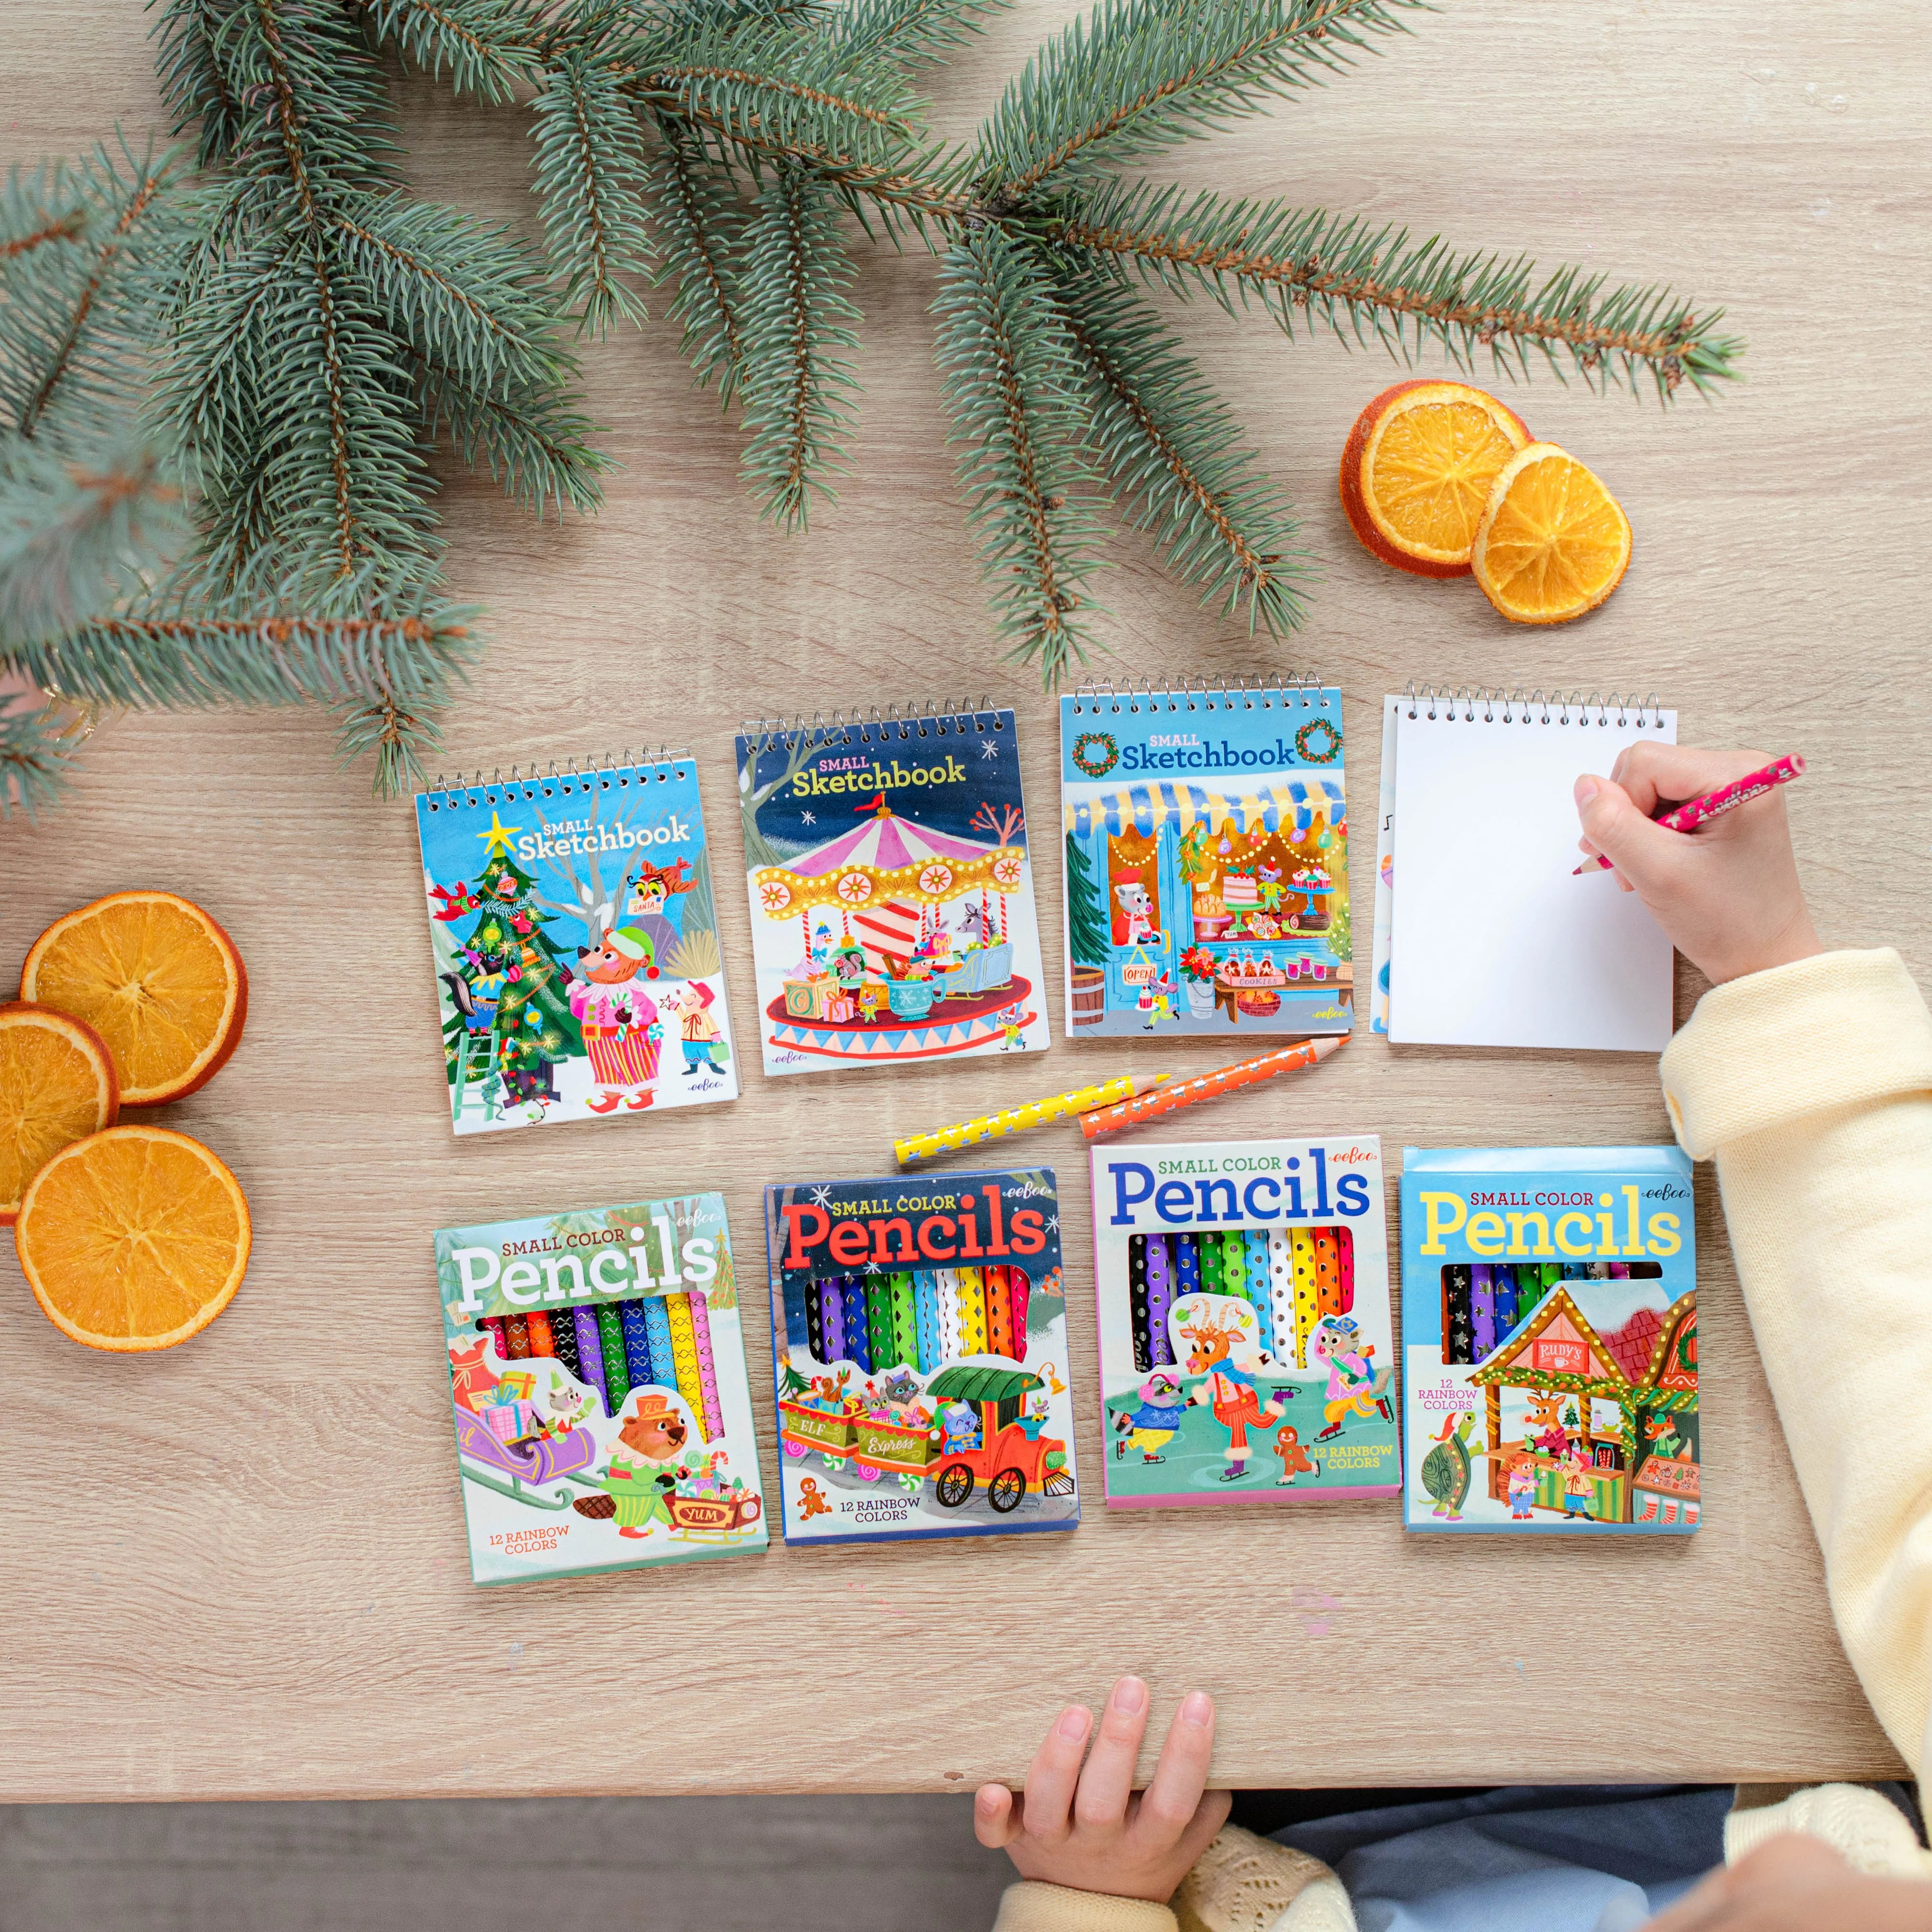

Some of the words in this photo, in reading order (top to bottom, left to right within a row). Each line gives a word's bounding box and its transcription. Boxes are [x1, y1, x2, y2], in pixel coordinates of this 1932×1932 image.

[1150, 734, 1199, 747] SMALL
[1122, 739, 1295, 770] Sketchbook
[819, 756, 869, 772] SMALL
[792, 755, 966, 796] Sketchbook
[543, 819, 593, 836] SMALL
[518, 816, 690, 860] Sketchbook
[633, 901, 655, 912] SANTA
[1128, 969, 1152, 980] OPEN
[1239, 978, 1277, 986] COOKIES
[1158, 1159, 1218, 1174] SMALL
[1223, 1157, 1281, 1172] COLOR
[1108, 1148, 1370, 1225] Pencils
[832, 1198, 893, 1217] SMALL
[896, 1195, 956, 1213] COLOR
[1471, 1192, 1530, 1206] SMALL
[1535, 1192, 1594, 1206] COLOR
[781, 1185, 1046, 1268] Pencils
[1420, 1185, 1682, 1257] Pencils
[502, 1237, 562, 1256] SMALL
[566, 1228, 626, 1248] COLOR
[452, 1215, 718, 1312] Pencils
[1540, 1344, 1582, 1359] RUDY'S
[1440, 1379, 1453, 1388] 12
[1418, 1390, 1477, 1399] RAINBOW
[1424, 1400, 1473, 1410] COLORS
[800, 1419, 826, 1436] ELF
[867, 1437, 916, 1455] Express
[1313, 1447, 1327, 1458] 12
[1330, 1445, 1393, 1458] RAINBOW
[1327, 1457, 1380, 1469] COLORS
[840, 1502, 854, 1512] 12
[856, 1497, 920, 1511] RAINBOW
[855, 1510, 908, 1522] COLORS
[490, 1535, 503, 1545] 12
[506, 1525, 569, 1543] RAINBOW
[505, 1539, 557, 1555] COLORS
